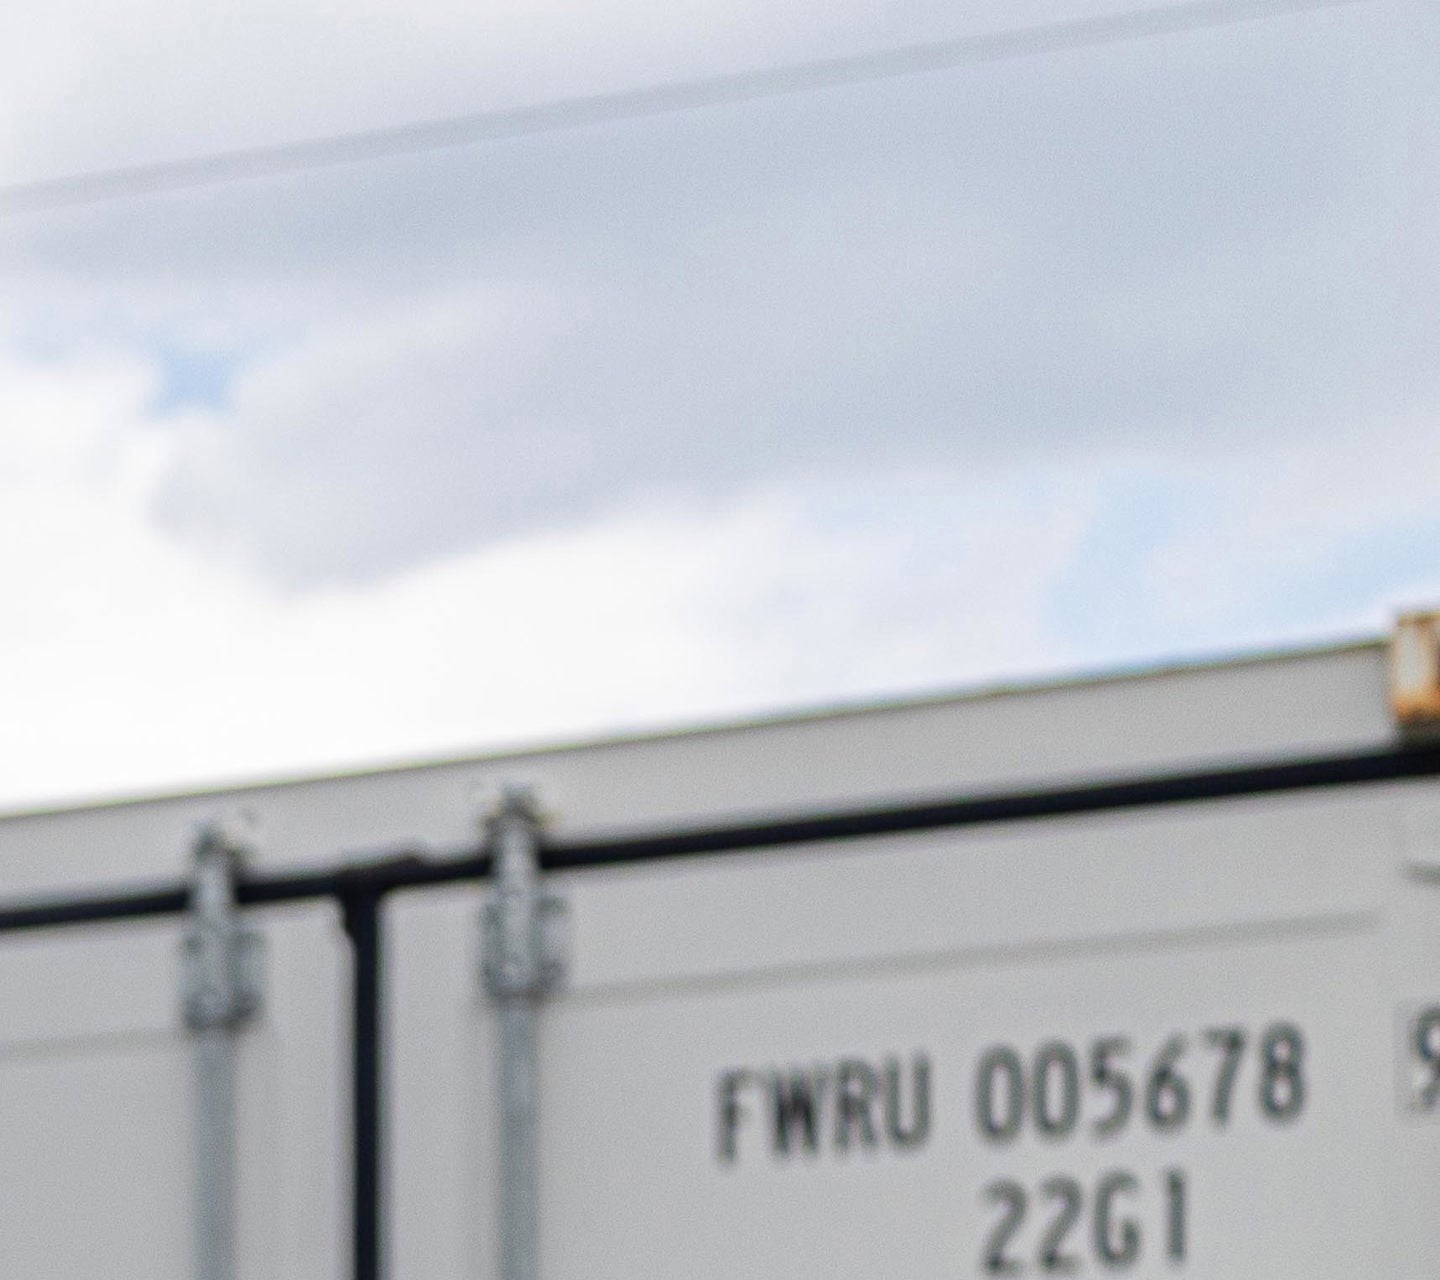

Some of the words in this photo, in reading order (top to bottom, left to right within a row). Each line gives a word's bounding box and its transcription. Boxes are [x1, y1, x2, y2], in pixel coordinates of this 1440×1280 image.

[714, 1051, 933, 1167] FWRU
[973, 1020, 1308, 1146] 005678
[980, 1168, 1189, 1280] 22G1
